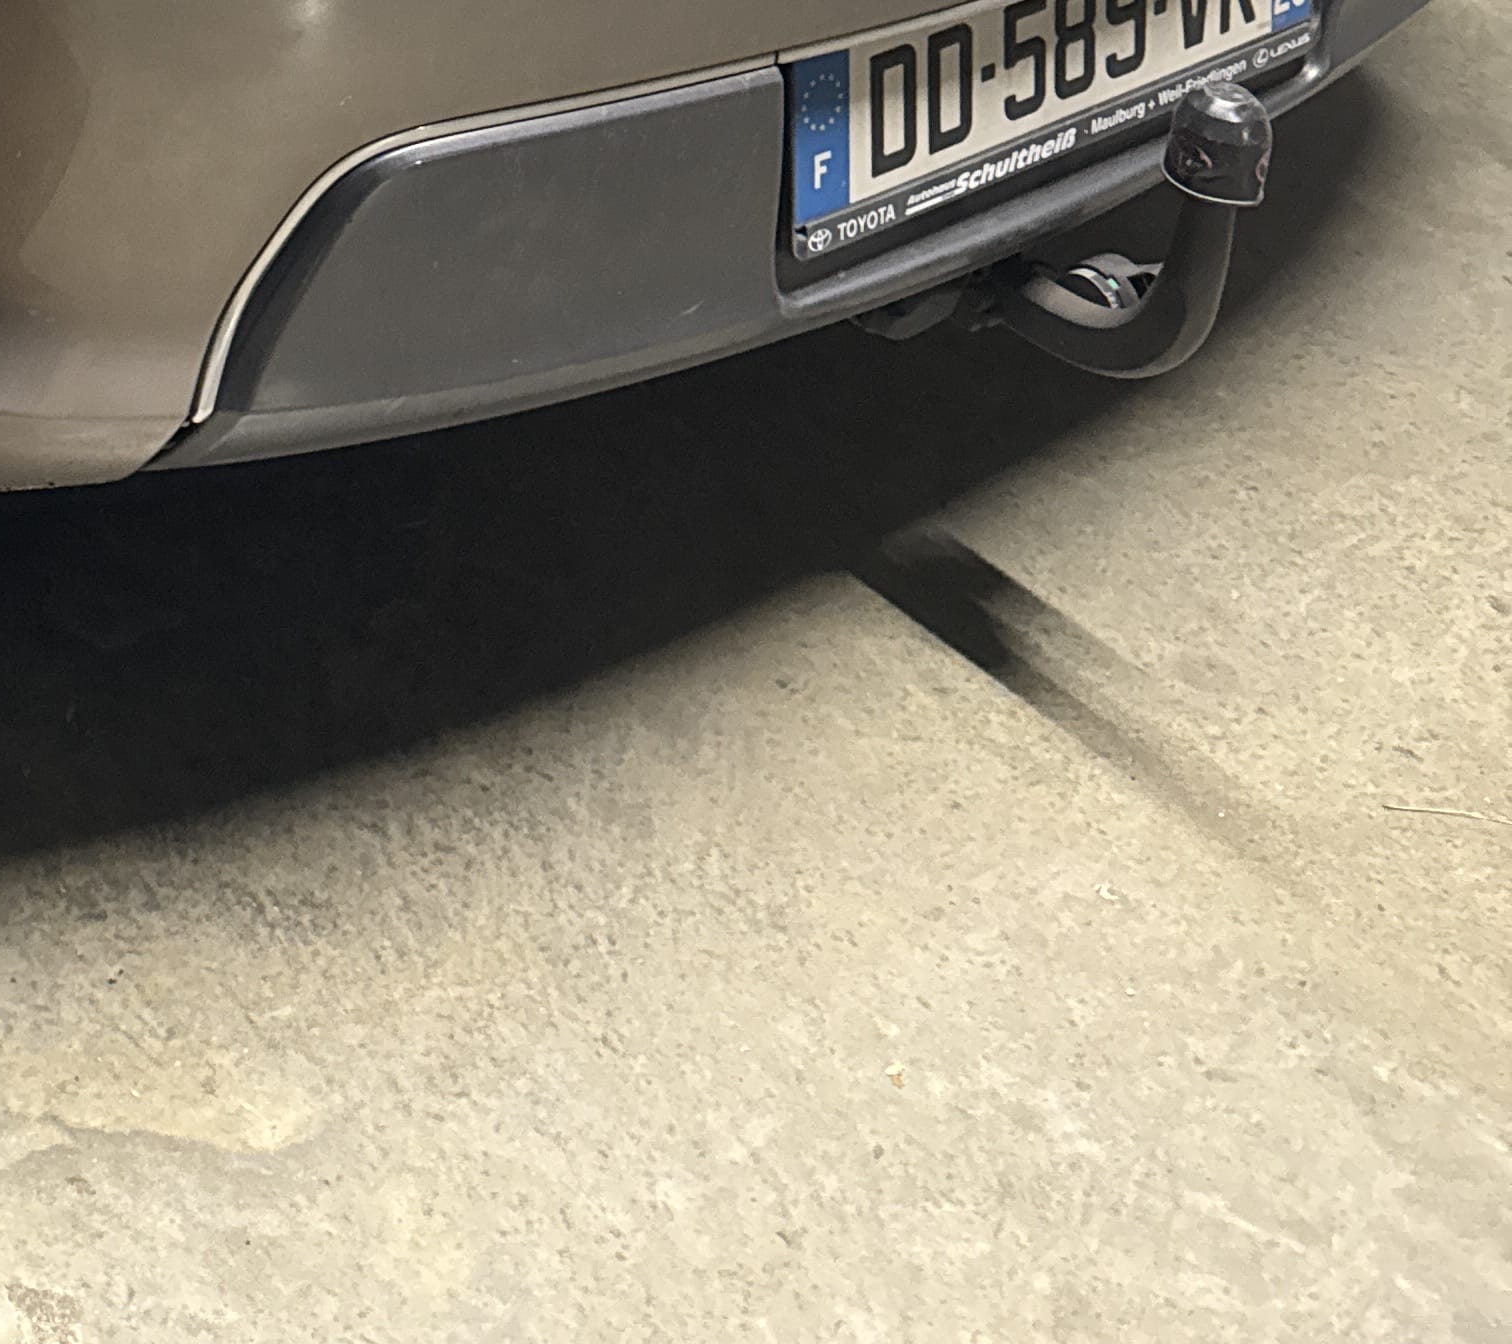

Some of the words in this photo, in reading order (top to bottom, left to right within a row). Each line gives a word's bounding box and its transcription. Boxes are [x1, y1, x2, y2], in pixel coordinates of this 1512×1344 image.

[813, 150, 833, 190] F
[837, 203, 896, 241] TOYOTA
[907, 178, 957, 206] Autohaus
[955, 126, 1078, 194] Schultheiß
[1091, 101, 1147, 135] Maulburg
[1269, 32, 1311, 58] LEXUS
